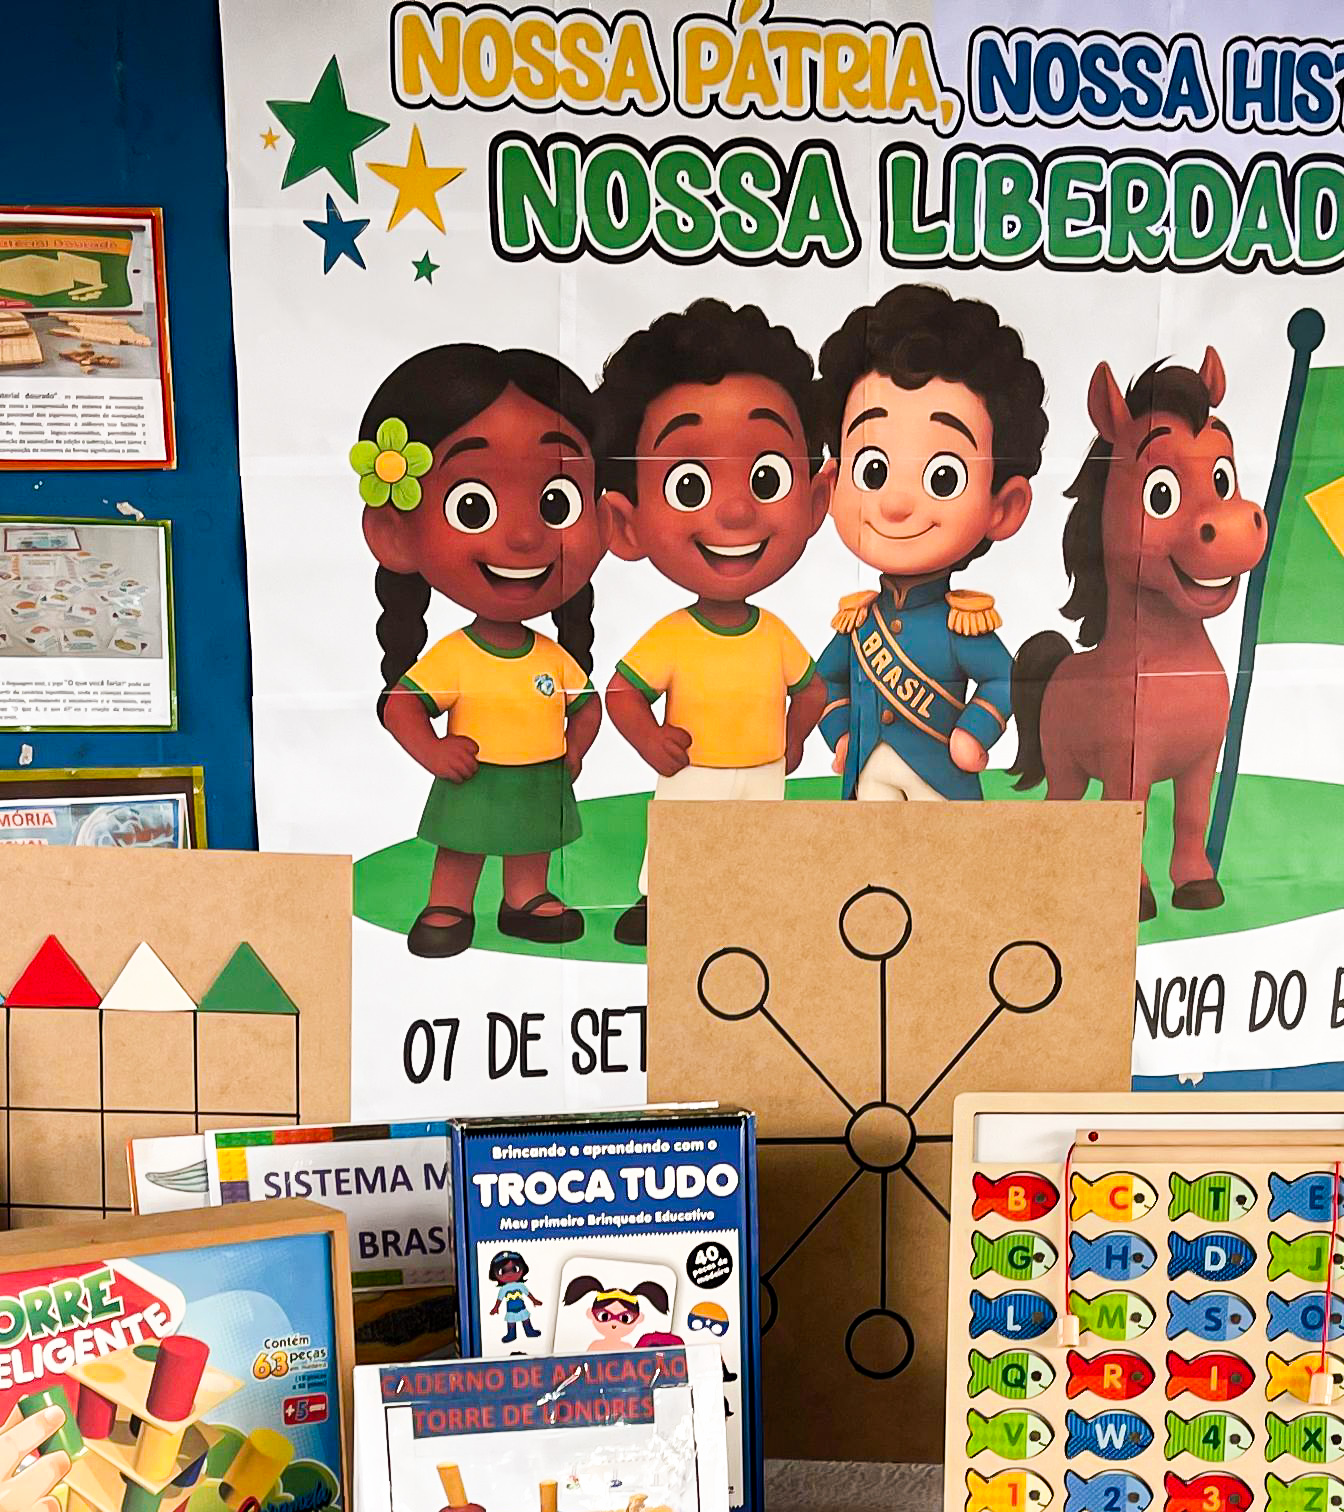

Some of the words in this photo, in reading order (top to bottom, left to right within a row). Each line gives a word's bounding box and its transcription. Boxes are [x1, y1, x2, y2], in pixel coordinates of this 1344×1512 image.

[397, 11, 660, 107] NOSSA
[680, 0, 956, 126] PÁTRIA,
[976, 34, 1212, 123] NOSSA
[497, 141, 854, 256] NOSSA
[863, 630, 935, 719] BRASIL
[1249, 970, 1307, 1033] DO
[404, 1018, 460, 1084] 07
[487, 1012, 548, 1080] DE
[492, 1143, 566, 1160] Brincando
[570, 1145, 579, 1157] e
[583, 1139, 670, 1159] aprendendo
[674, 1140, 704, 1151] com
[708, 1140, 717, 1150] o
[264, 1165, 413, 1199] SISTEMA
[472, 1169, 615, 1207] TROCA
[620, 1163, 739, 1201] TUDO
[1007, 1186, 1028, 1211] B
[1109, 1186, 1129, 1210] C
[1208, 1187, 1226, 1210] T
[1308, 1186, 1324, 1210] E
[500, 1217, 528, 1230] Meu
[531, 1214, 584, 1231] primeiro
[587, 1211, 652, 1228] Brinquedo
[655, 1208, 714, 1222] Educativo
[695, 1246, 719, 1265] 40
[1008, 1246, 1031, 1271] G
[1105, 1245, 1129, 1269] H
[1203, 1246, 1227, 1271] D
[1309, 1247, 1322, 1271] J
[1006, 1306, 1022, 1330] L
[1097, 1305, 1125, 1329] M
[1204, 1306, 1223, 1331] S
[1300, 1305, 1323, 1331] O
[264, 1335, 309, 1349] Contém
[253, 1351, 289, 1379] 63
[290, 1349, 326, 1363] peças
[381, 1370, 504, 1397] CADERNO
[512, 1366, 543, 1388] DE
[552, 1352, 687, 1386] APLICAÇÃO
[1002, 1363, 1026, 1391] Q
[1104, 1364, 1122, 1388] R
[1210, 1365, 1218, 1390] I
[414, 1404, 496, 1433] TORRE
[504, 1404, 538, 1426] DE
[543, 1395, 654, 1424] LONDRES
[1003, 1423, 1024, 1448] V
[1095, 1424, 1126, 1450] W
[1202, 1425, 1220, 1449] 4
[1302, 1426, 1323, 1451] X
[1007, 1484, 1018, 1506] 1
[1103, 1487, 1122, 1511] 2
[1202, 1486, 1220, 1512] 3
[1303, 1488, 1322, 1512] Z
